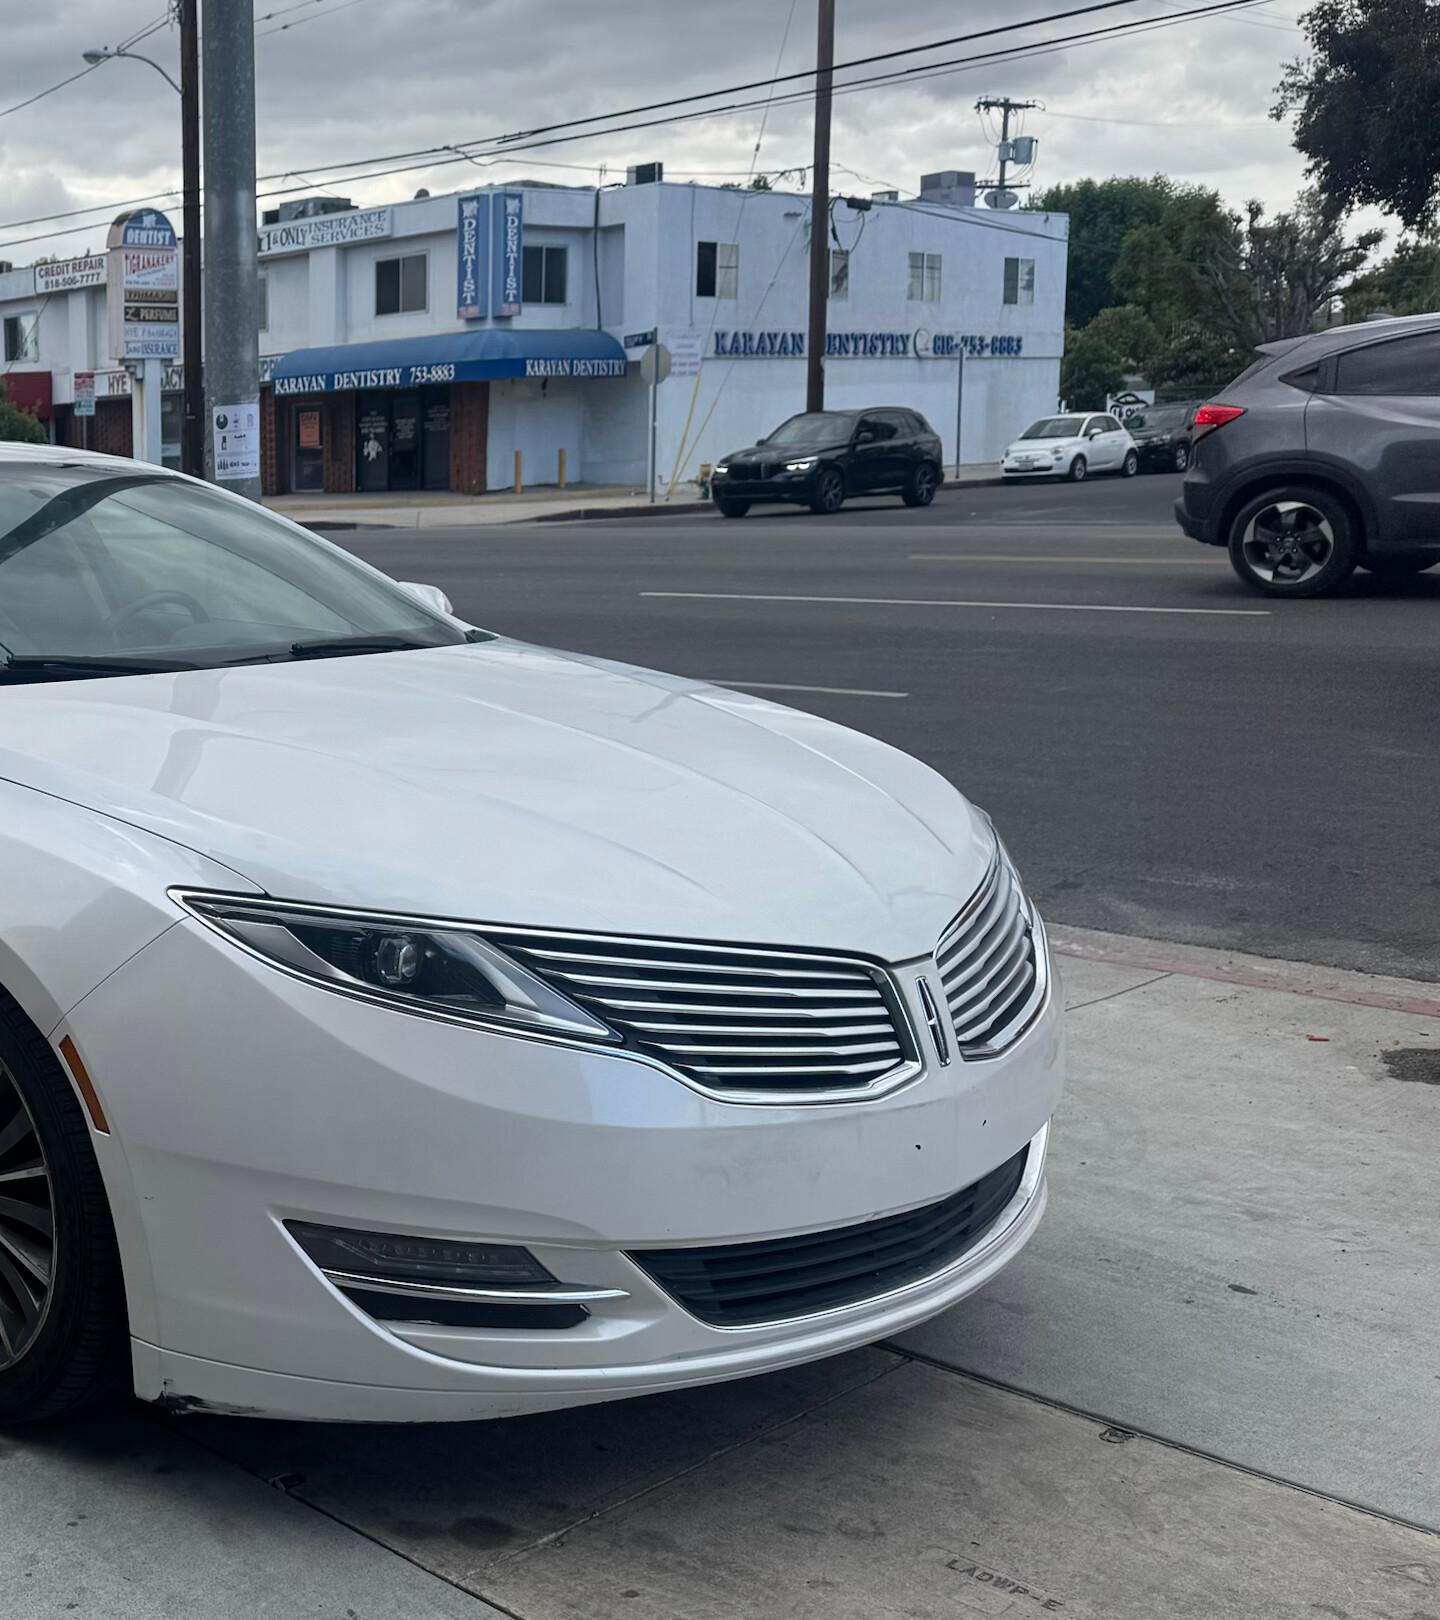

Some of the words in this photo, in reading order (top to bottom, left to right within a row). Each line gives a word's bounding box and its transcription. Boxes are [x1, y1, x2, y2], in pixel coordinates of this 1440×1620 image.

[308, 209, 387, 234] INSURANCE
[126, 228, 171, 245] DENTIST
[280, 227, 308, 247] ONLY
[311, 222, 385, 245] SERVICES
[39, 263, 70, 279] CREDIT
[72, 258, 104, 273] REPAIR
[462, 218, 477, 304] DENTIST
[505, 215, 519, 302] DENTIST
[714, 331, 805, 356] KARAYAN
[825, 332, 910, 355] ENTISTRY
[275, 374, 326, 394] KARAYAN
[334, 368, 402, 390] DENTISTRY
[410, 364, 455, 384] 753-8883
[526, 359, 570, 376] KARAYAN
[573, 359, 626, 376] DENTISTRY
[108, 373, 127, 393] HYE
